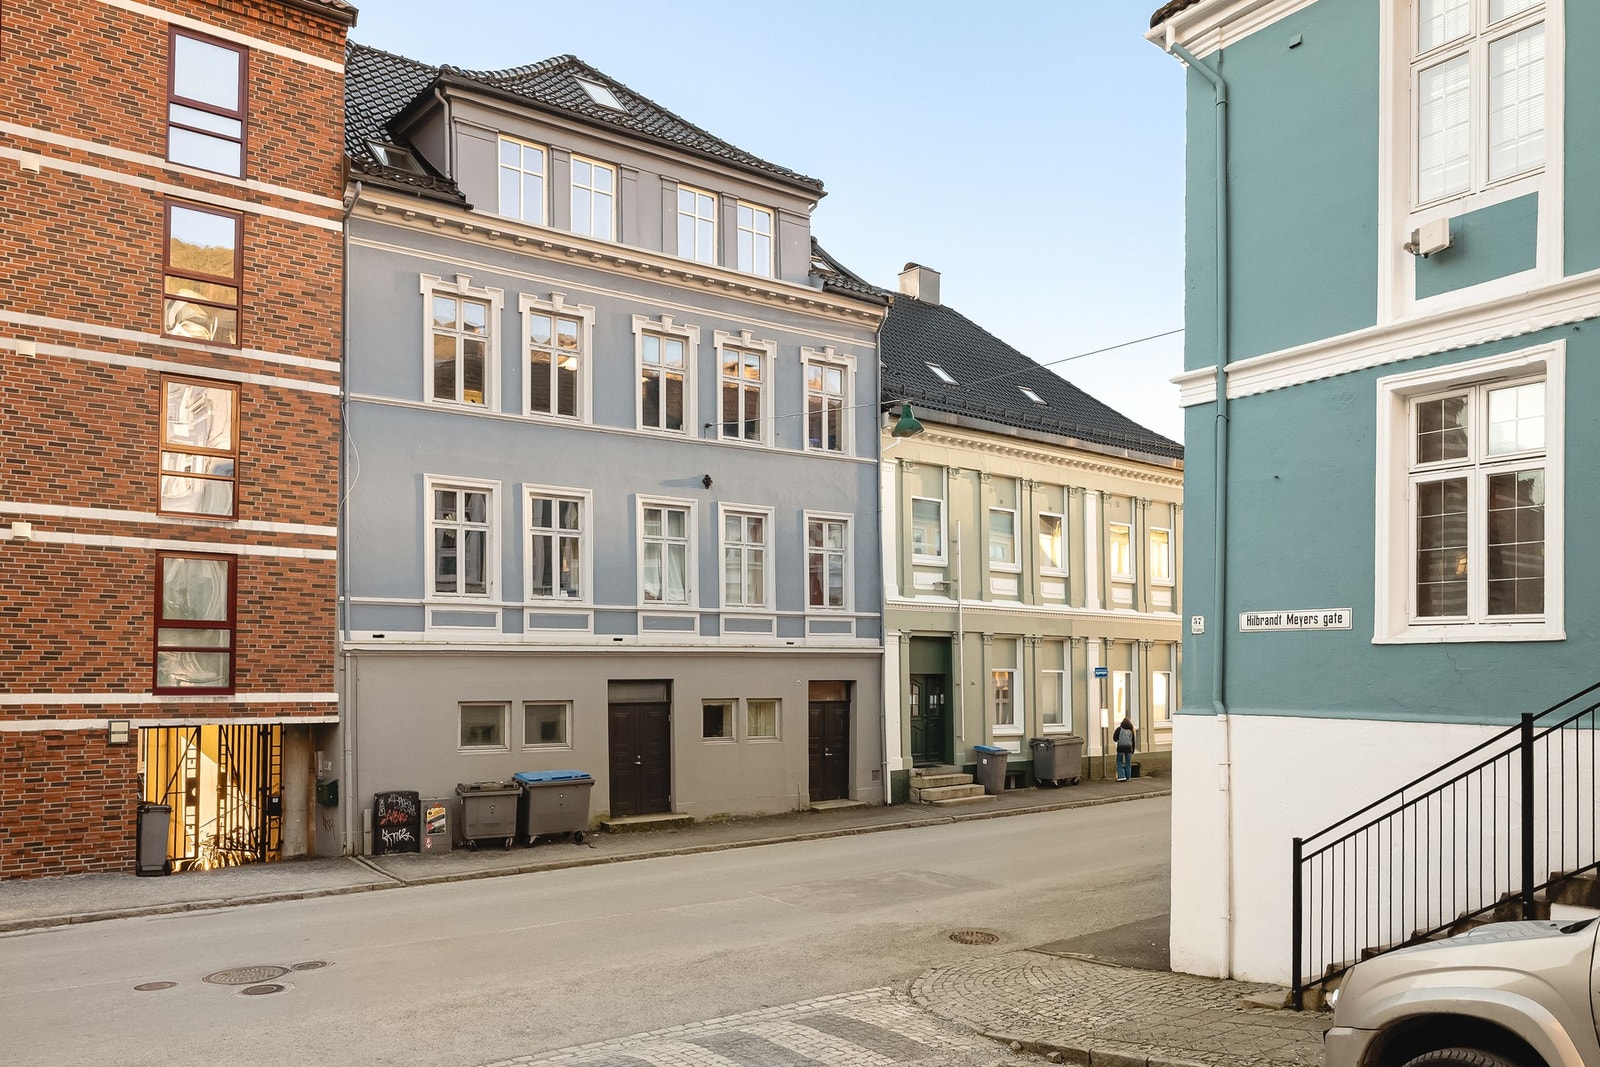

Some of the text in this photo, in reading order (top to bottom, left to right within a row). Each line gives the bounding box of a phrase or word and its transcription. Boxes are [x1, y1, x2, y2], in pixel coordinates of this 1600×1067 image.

[1246, 612, 1343, 627] Hilbrandt Meyers gate
